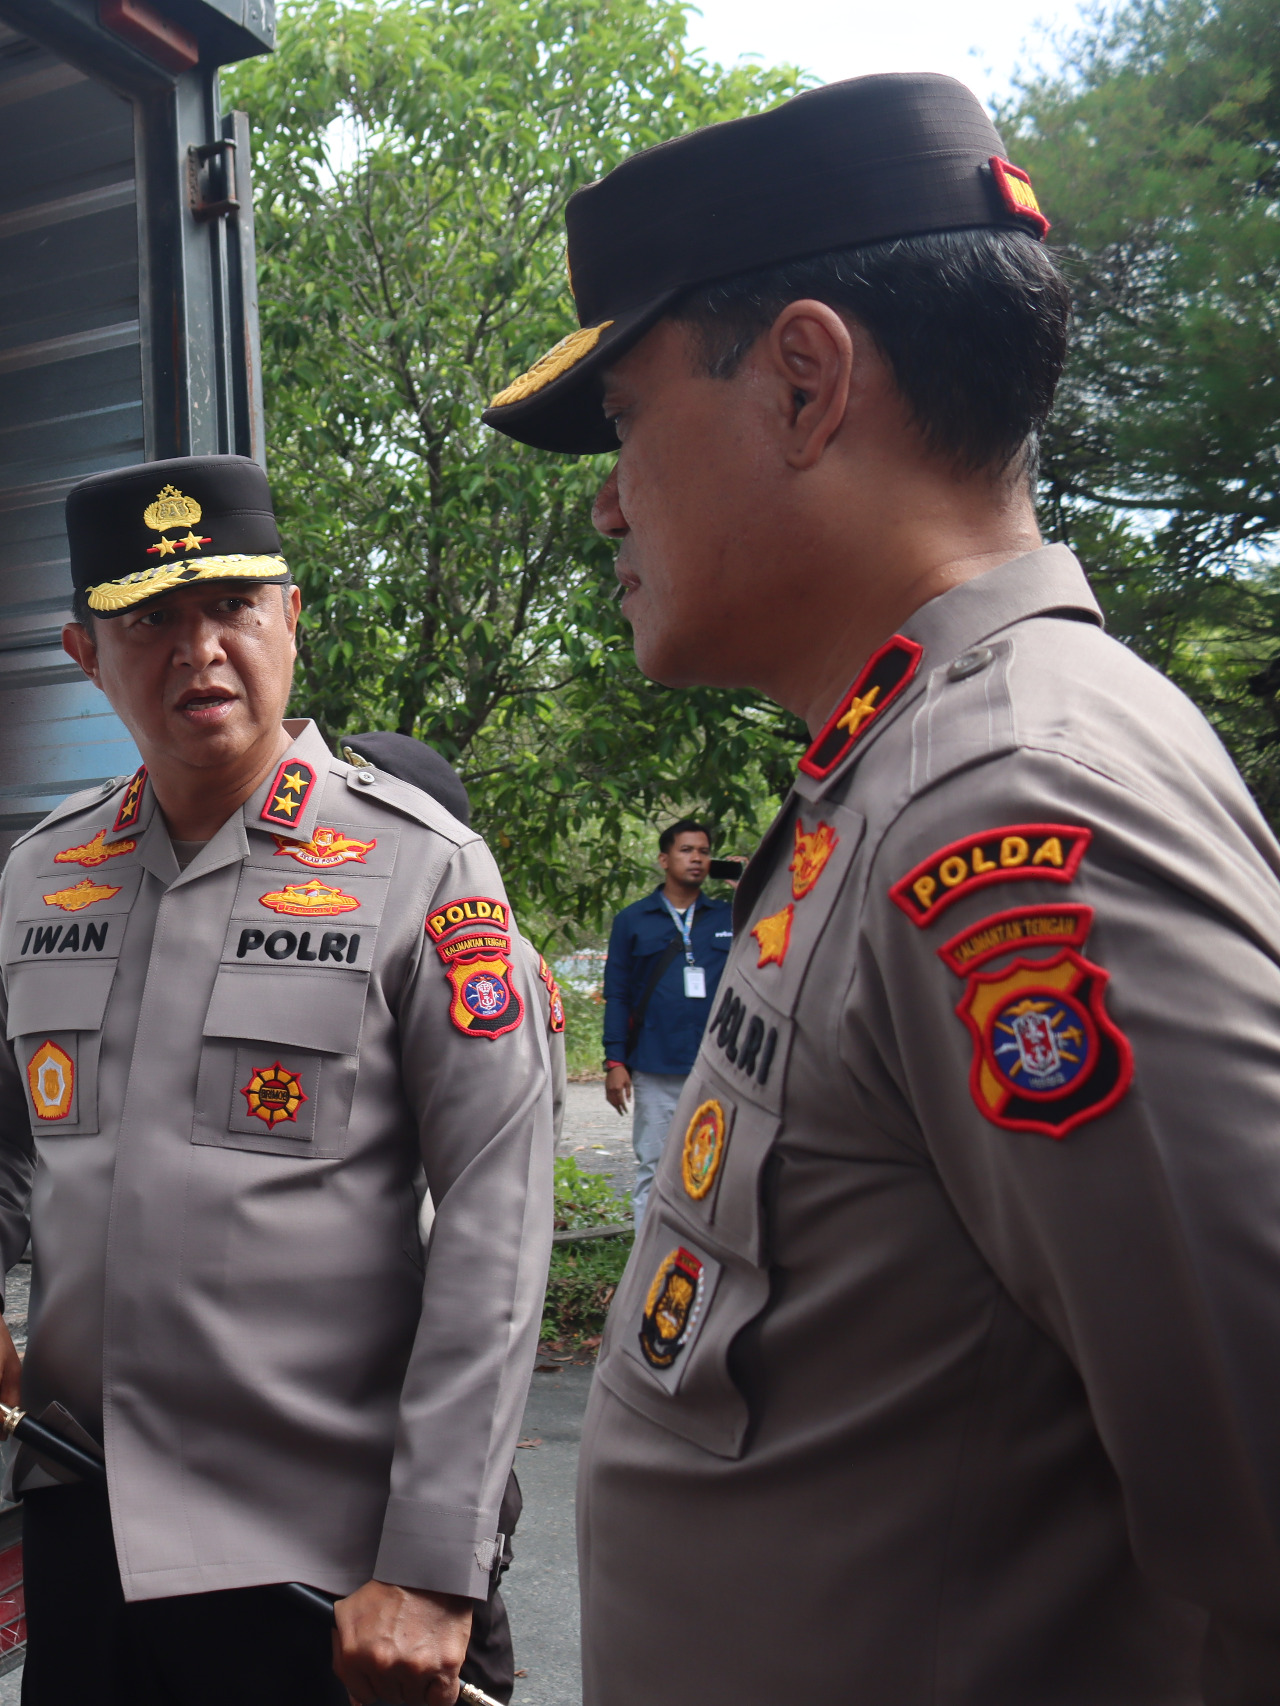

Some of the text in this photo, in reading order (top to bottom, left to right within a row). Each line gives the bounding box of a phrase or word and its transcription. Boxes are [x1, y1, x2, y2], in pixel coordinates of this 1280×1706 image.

[912, 836, 1064, 909] POLDA
[430, 901, 505, 935] POLDA
[20, 922, 110, 956] IWAN
[235, 928, 362, 965] POLRI
[443, 937, 508, 957] KALIMANTAN TENGAH
[708, 986, 778, 1086] POLRI
